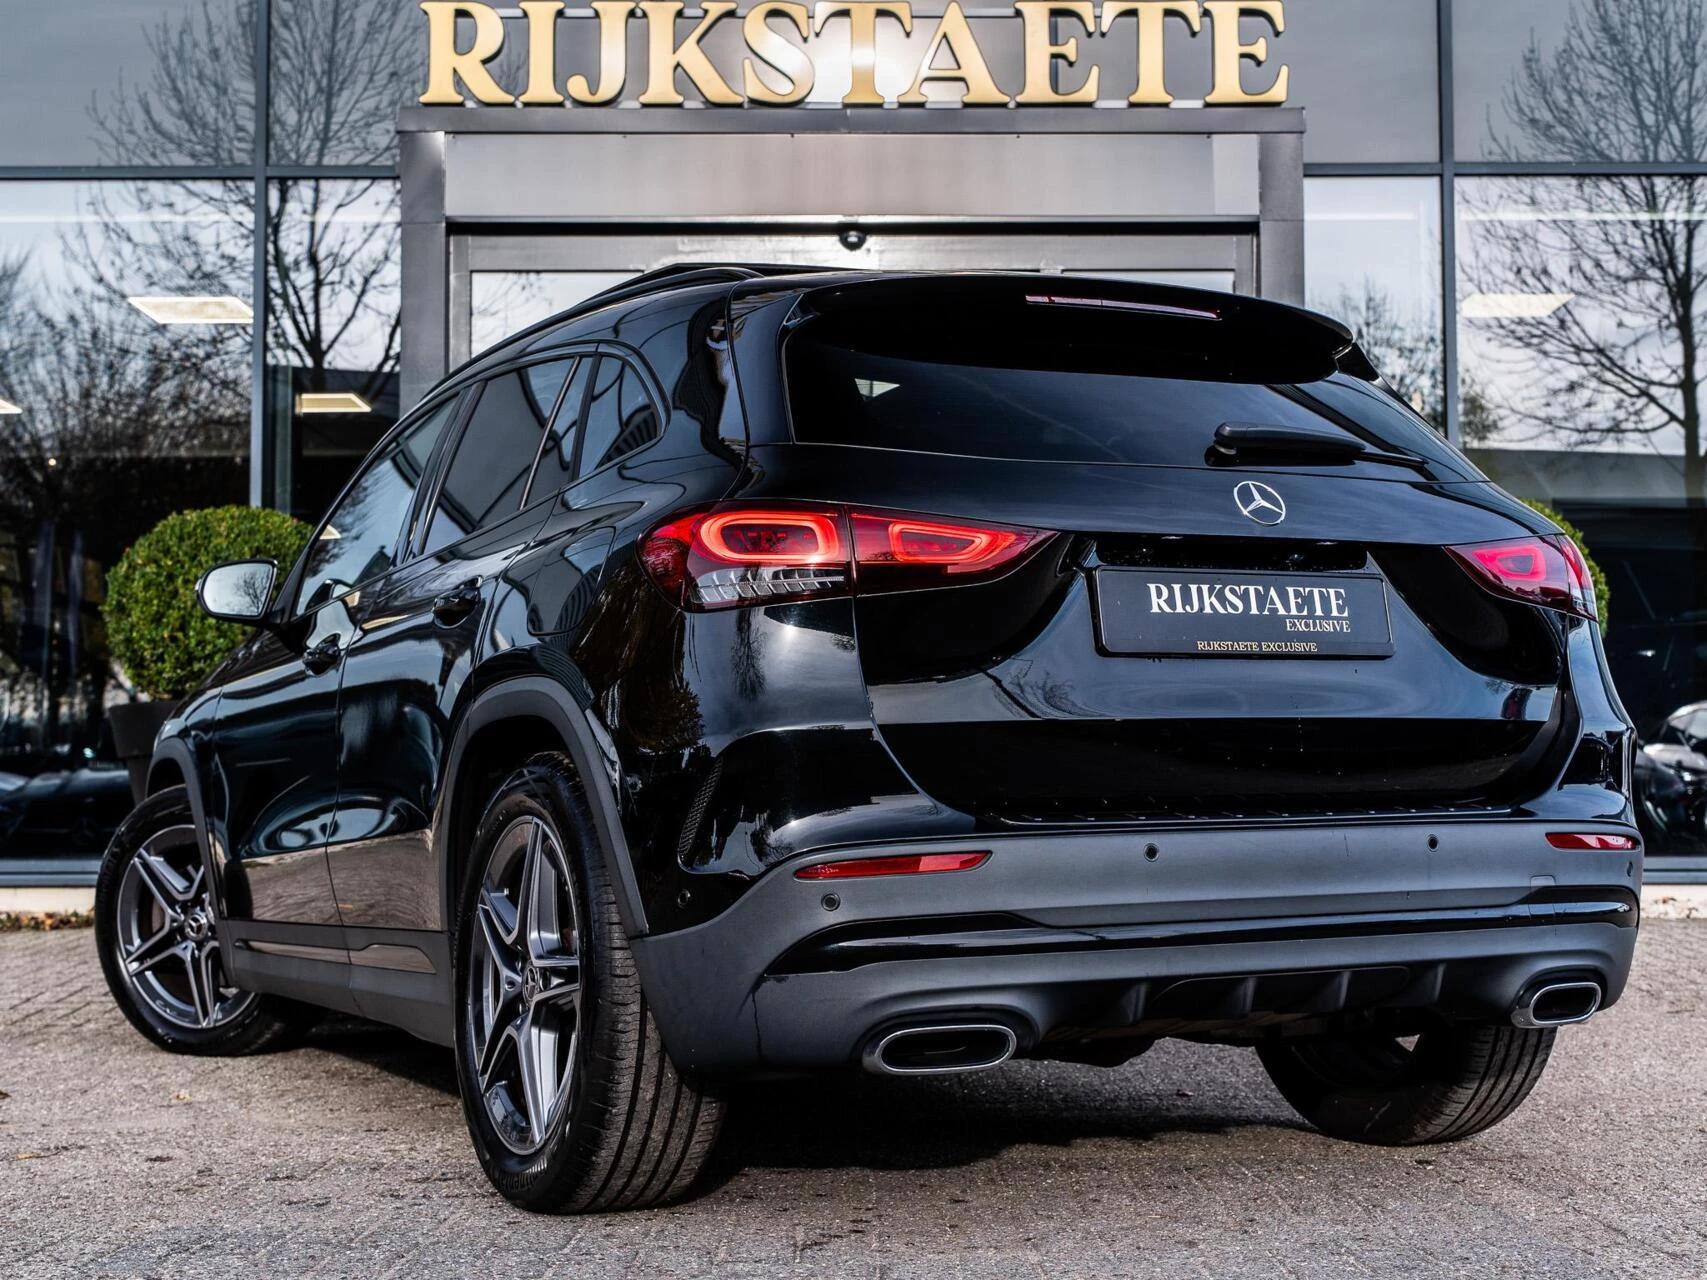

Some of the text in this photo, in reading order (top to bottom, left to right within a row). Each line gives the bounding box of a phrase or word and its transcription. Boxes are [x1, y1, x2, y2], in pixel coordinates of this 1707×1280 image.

[418, 0, 1289, 107] RIJKSTAETE
[1146, 583, 1349, 617] RIJKSTAETE
[1286, 619, 1351, 633] EXCLUSIVE
[1196, 641, 1318, 653] RIJKSTAETE EXCLUSIVE
